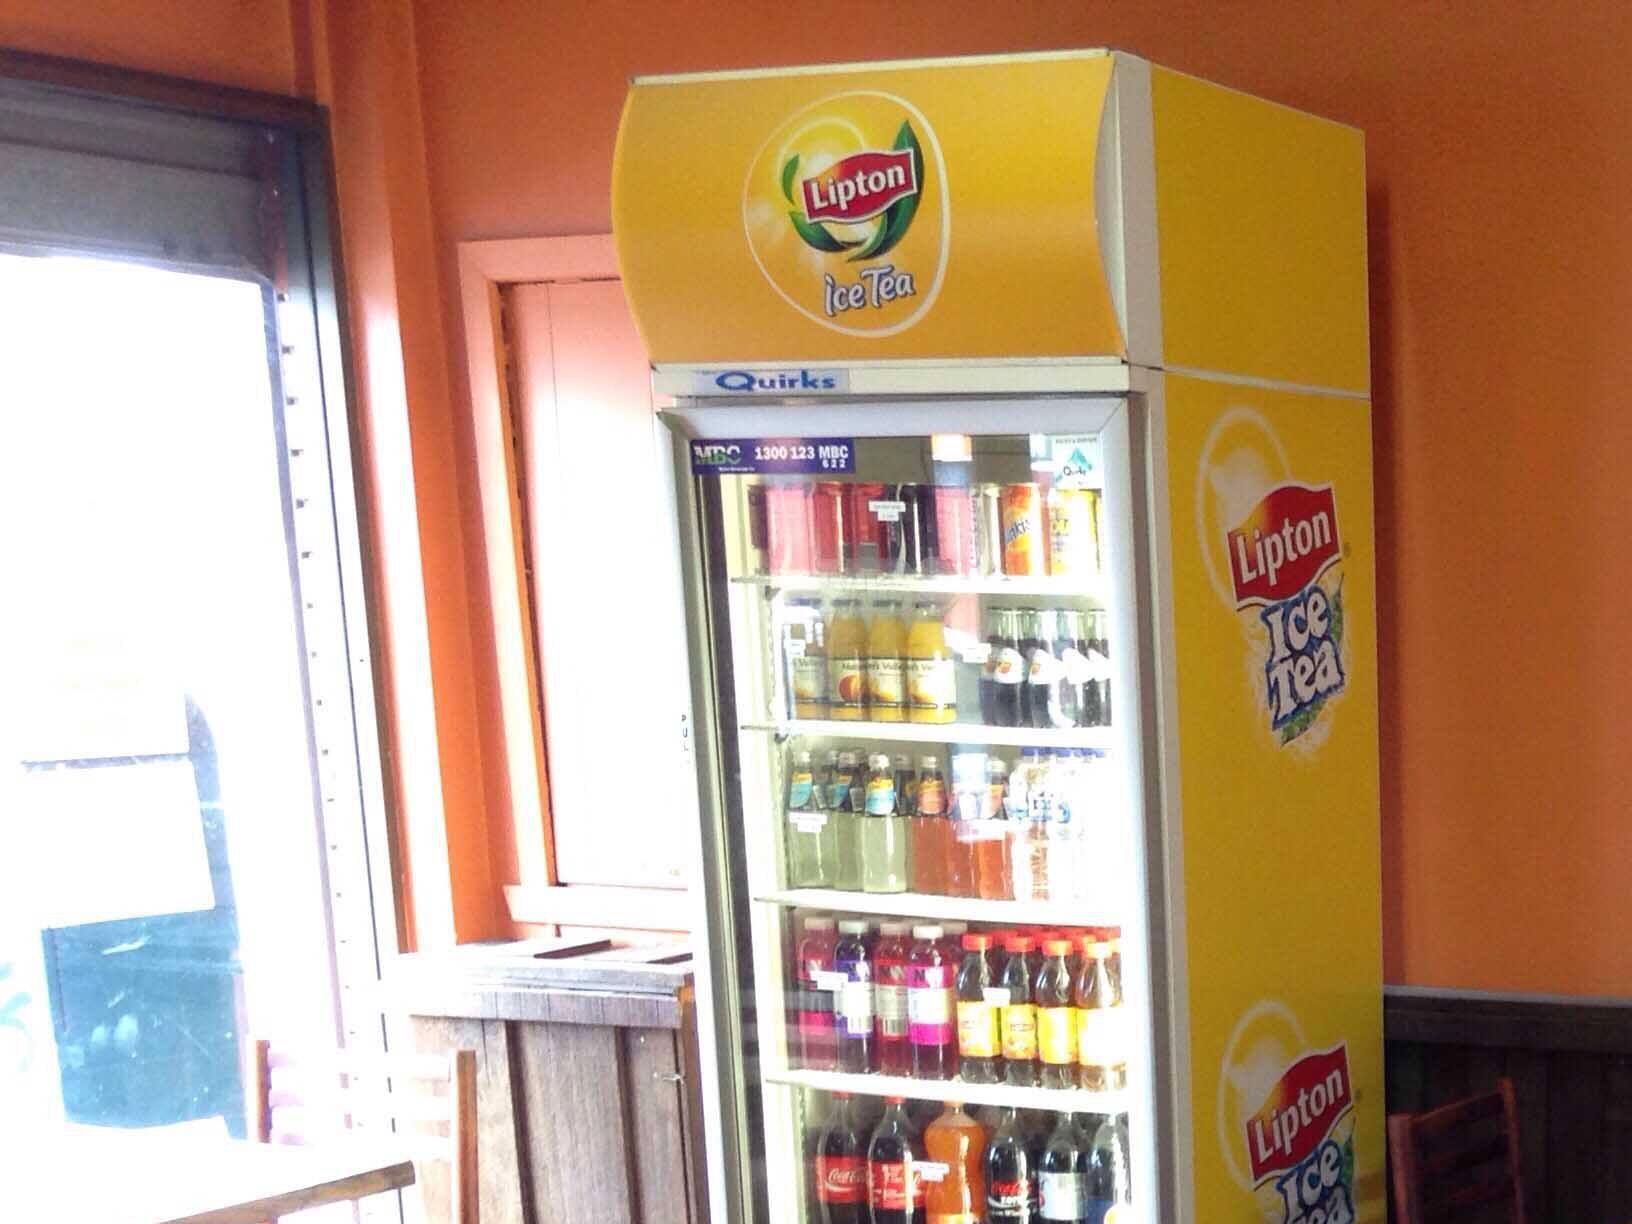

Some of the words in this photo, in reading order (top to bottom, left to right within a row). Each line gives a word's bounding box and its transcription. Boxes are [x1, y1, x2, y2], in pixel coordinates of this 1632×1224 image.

[809, 164, 906, 210] Lipton
[860, 264, 916, 309] Tea
[715, 370, 836, 392] Quirks
[754, 446, 788, 461] 1300
[791, 446, 815, 460] 123
[819, 445, 849, 460] MBC
[1236, 510, 1332, 586] Lipton
[1264, 588, 1330, 664] Ice
[1269, 640, 1342, 724] Tea
[1254, 1068, 1345, 1163] Lipton
